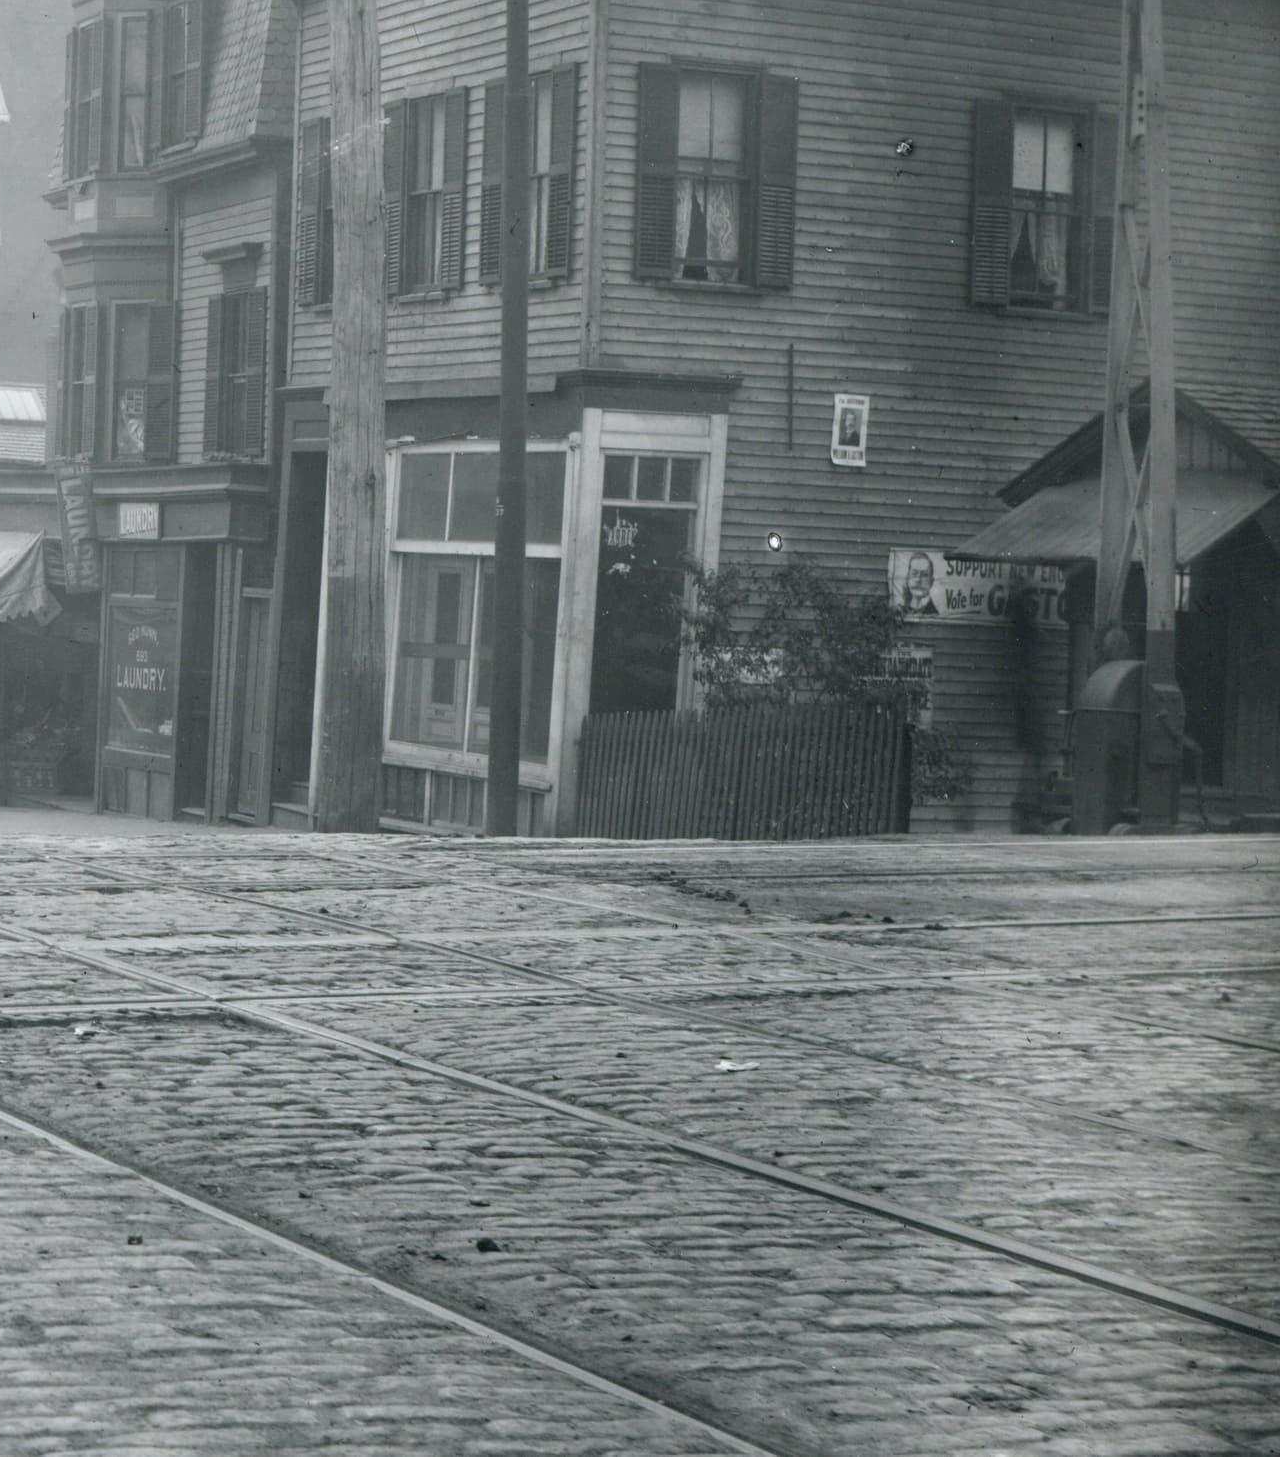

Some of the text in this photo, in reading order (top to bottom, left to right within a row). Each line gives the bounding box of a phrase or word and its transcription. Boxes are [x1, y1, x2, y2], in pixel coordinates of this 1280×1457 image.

[119, 507, 158, 536] LAUNDRY
[945, 559, 1004, 579] SUPPORT
[945, 588, 967, 610] Vote
[969, 587, 985, 607] for
[117, 663, 167, 692] LAUNDRY.
